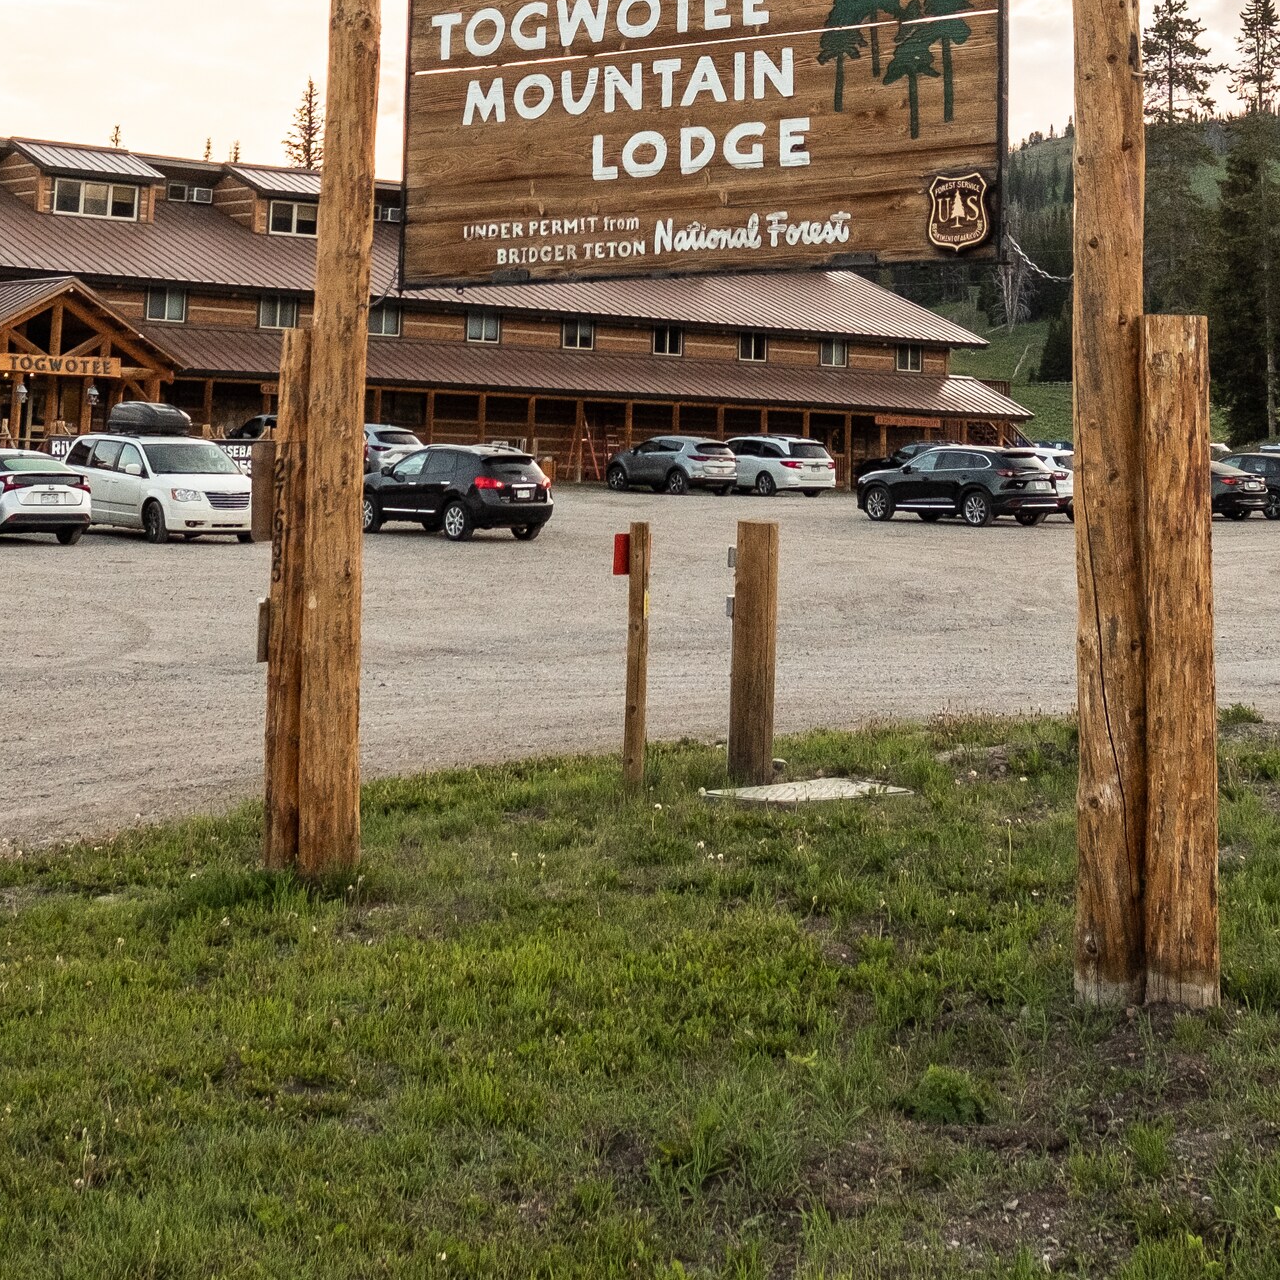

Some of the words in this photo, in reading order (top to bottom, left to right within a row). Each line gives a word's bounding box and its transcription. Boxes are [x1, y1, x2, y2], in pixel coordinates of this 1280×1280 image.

[462, 47, 795, 126] MOUNTAIN
[592, 117, 811, 181] LODGE
[935, 181, 956, 197] FOREST
[956, 180, 981, 193] SERVICE
[463, 222, 524, 241] UNDER
[528, 217, 599, 237] PERMIT
[603, 216, 640, 232] from
[496, 244, 578, 265] BRIDGER
[583, 240, 646, 260] TETON
[654, 212, 762, 255] National
[766, 210, 852, 248] Forest
[10, 355, 112, 375] TOGWOTEE
